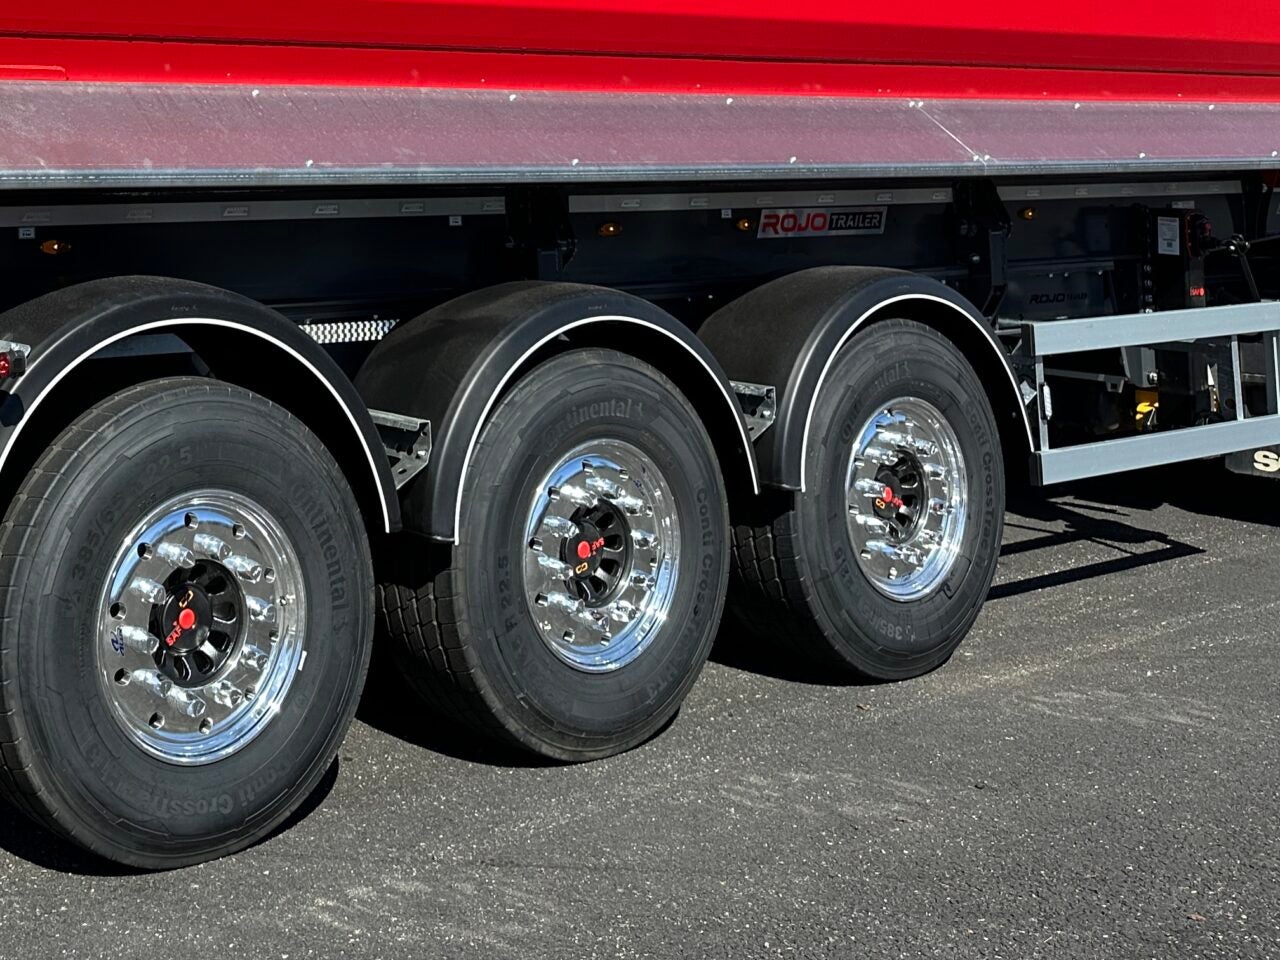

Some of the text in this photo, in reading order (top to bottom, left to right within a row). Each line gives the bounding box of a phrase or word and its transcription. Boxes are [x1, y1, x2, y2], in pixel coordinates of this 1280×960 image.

[761, 212, 880, 235] ROJO TRAILER
[1253, 450, 1280, 472] S
[696, 487, 714, 547] Conti
[166, 625, 182, 647] SAF
